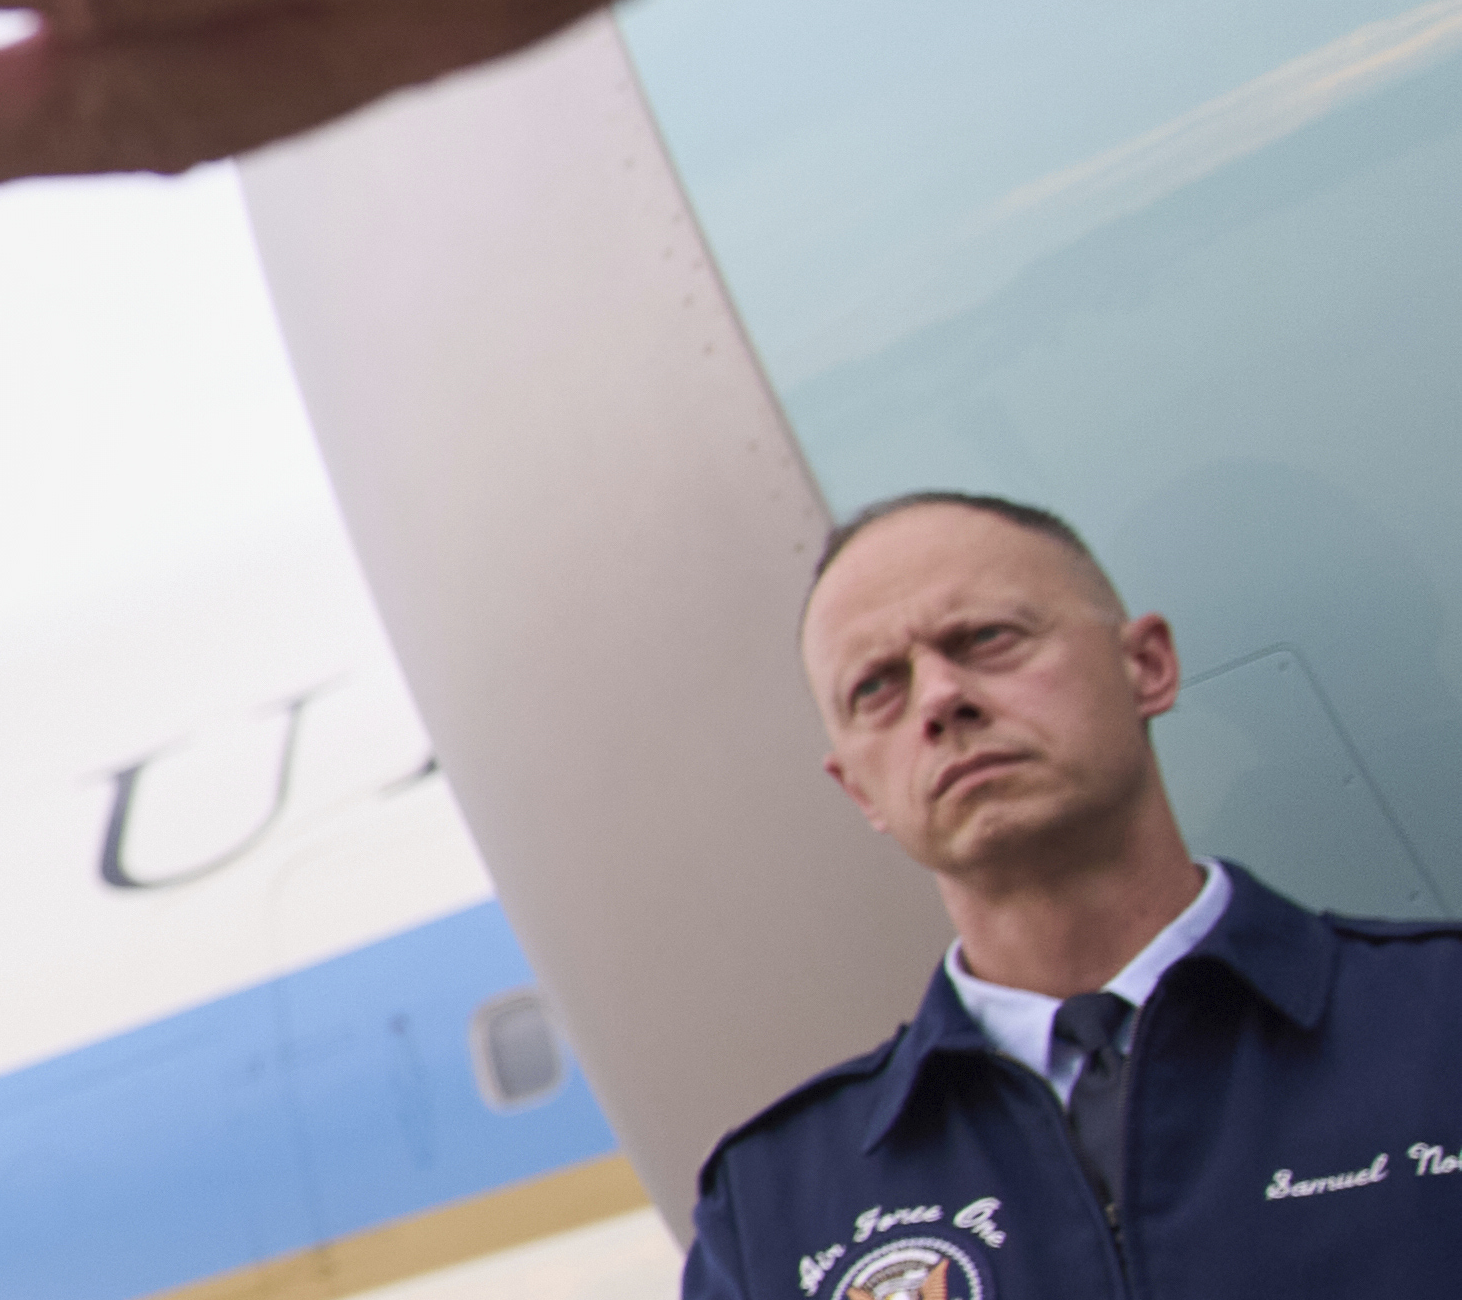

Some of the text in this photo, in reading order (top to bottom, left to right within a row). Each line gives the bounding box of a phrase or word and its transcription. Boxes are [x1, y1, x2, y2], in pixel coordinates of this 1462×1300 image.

[90, 672, 440, 892] U
[1265, 1141, 1462, 1200] Samuel No
[799, 1196, 1007, 1297] Air Force One
